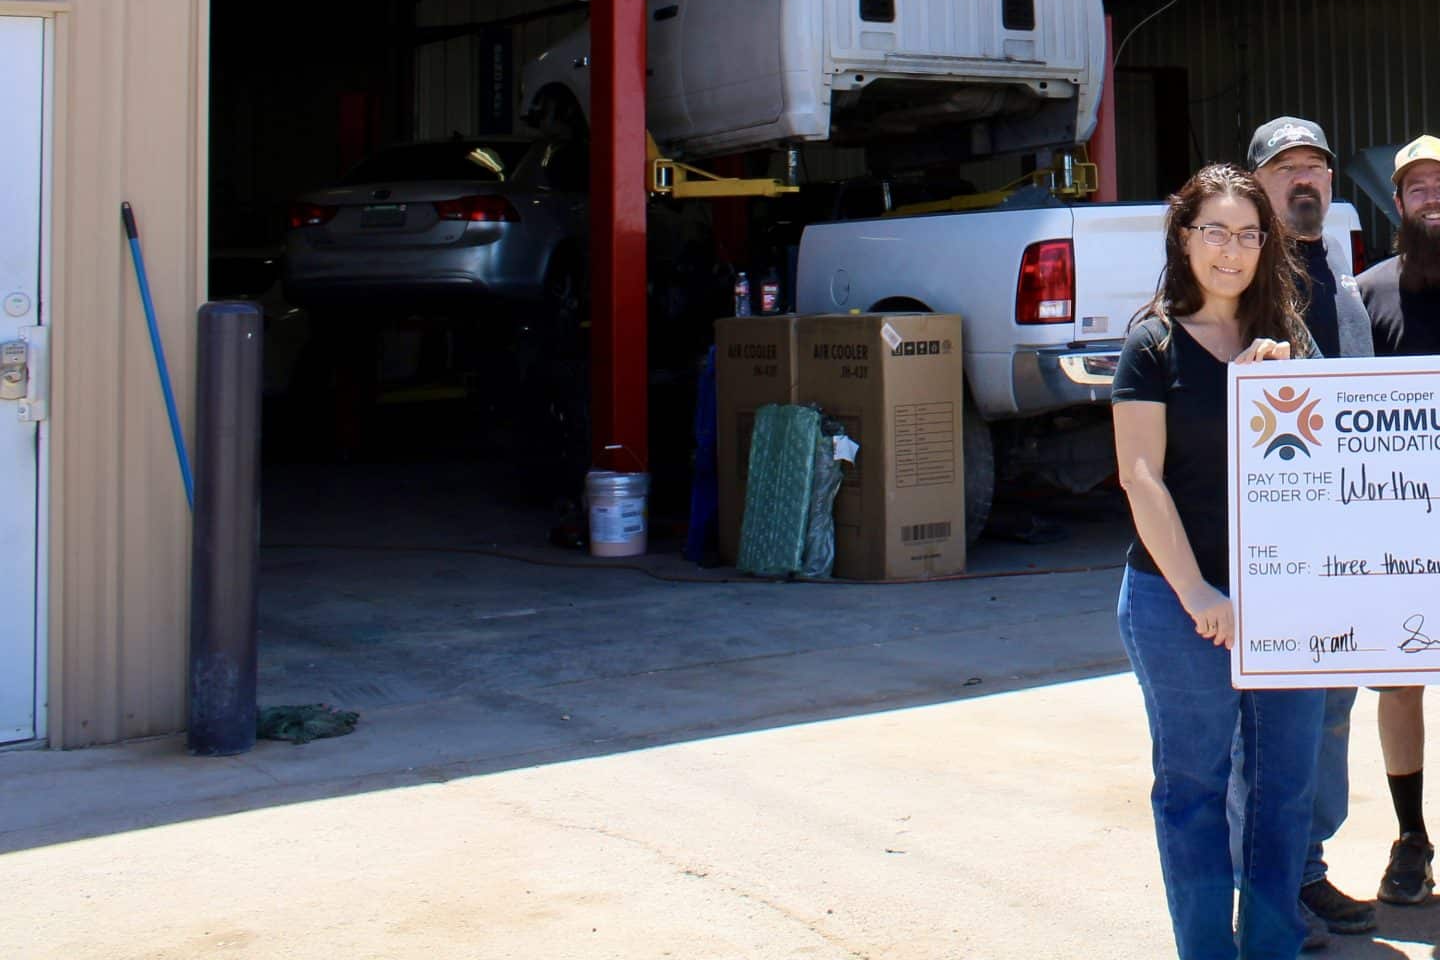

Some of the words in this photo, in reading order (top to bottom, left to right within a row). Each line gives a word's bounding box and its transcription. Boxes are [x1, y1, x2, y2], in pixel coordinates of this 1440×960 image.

[813, 343, 829, 360] AIR
[831, 343, 868, 361] COOLER
[1336, 391, 1388, 403] Florence
[1390, 390, 1435, 404] Copper
[1247, 473, 1277, 486] PAY
[1279, 472, 1299, 485] TO
[1301, 471, 1333, 485] THE
[1340, 463, 1432, 513] Worthy
[1247, 489, 1304, 503] ORDER
[1306, 489, 1331, 502] OF:
[1248, 545, 1278, 559] THE
[1248, 562, 1282, 576] SUM
[1286, 561, 1311, 575] OF:
[1322, 555, 1371, 578] three
[1250, 639, 1301, 653] MEMO:
[1309, 626, 1358, 664] grant
